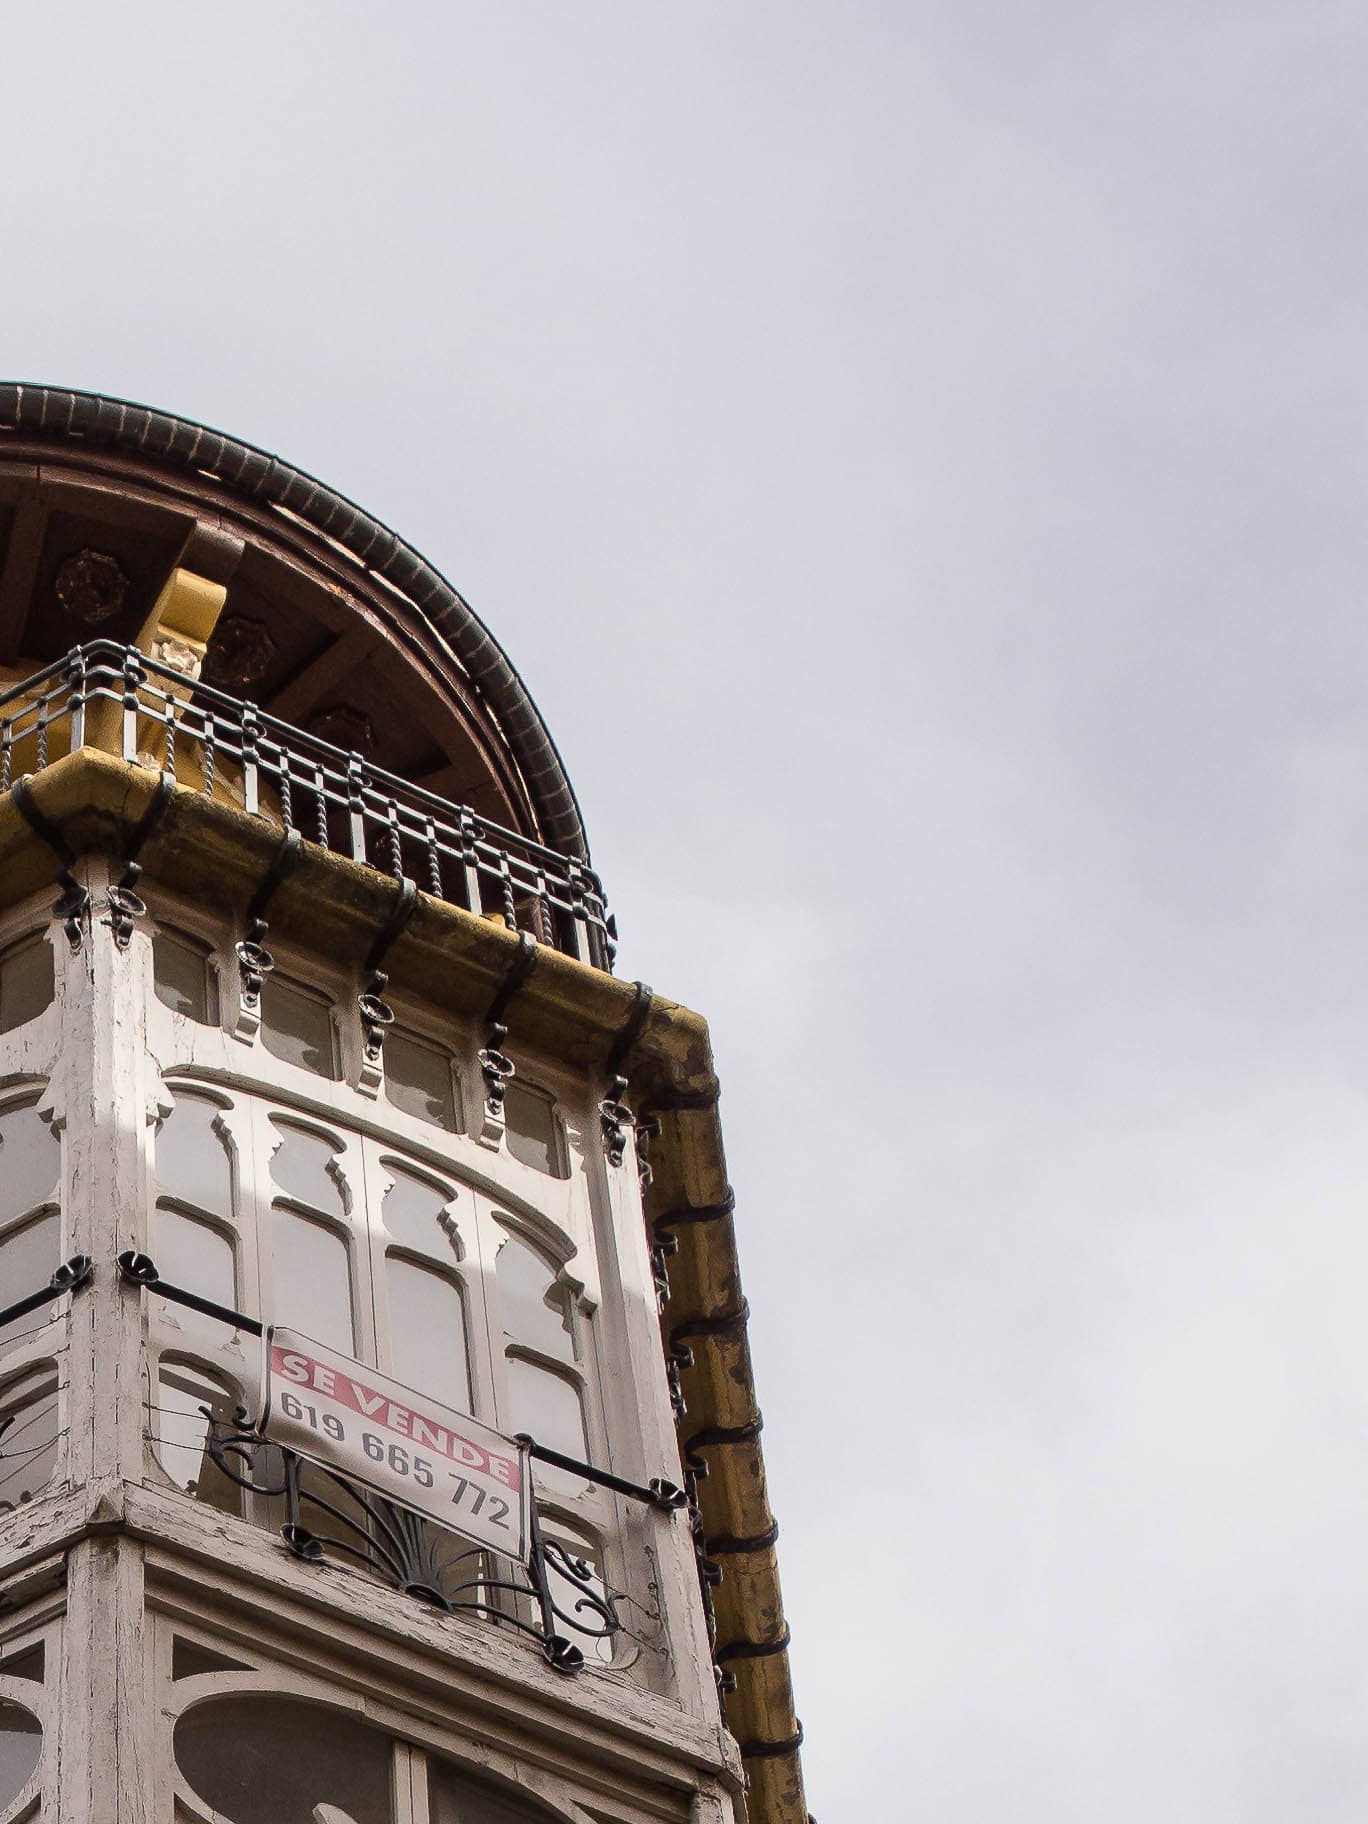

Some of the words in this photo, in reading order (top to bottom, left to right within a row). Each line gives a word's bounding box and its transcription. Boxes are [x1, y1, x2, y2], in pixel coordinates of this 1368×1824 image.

[280, 1392, 345, 1441] 619
[362, 1432, 433, 1488] 665
[448, 1472, 510, 1530] 772
[282, 1354, 336, 1393] SE
[352, 1383, 512, 1482] VENDE
